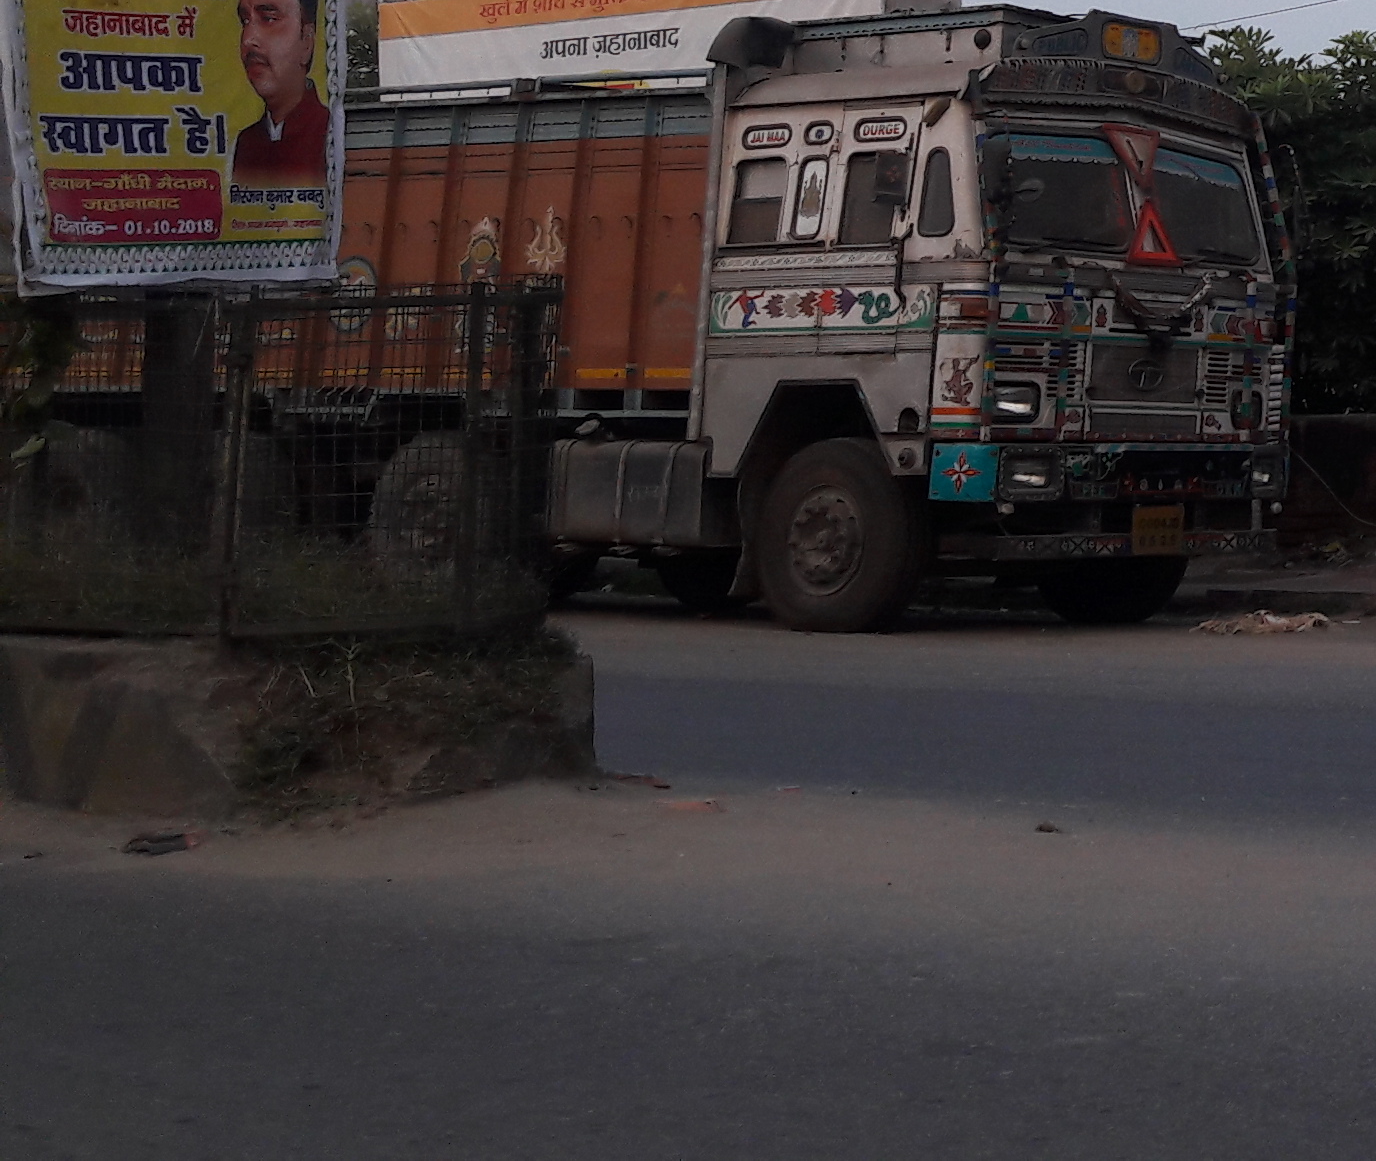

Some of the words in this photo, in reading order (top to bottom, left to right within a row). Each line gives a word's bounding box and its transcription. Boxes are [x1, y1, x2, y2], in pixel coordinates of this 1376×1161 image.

[62, 9, 170, 37] जहानाबाद
[177, 6, 198, 38] में
[540, 36, 590, 59] अपना
[59, 51, 203, 92] आपका
[39, 114, 170, 155] स्वागत
[81, 197, 180, 211] जहानाबाद
[266, 189, 294, 210] कुमार
